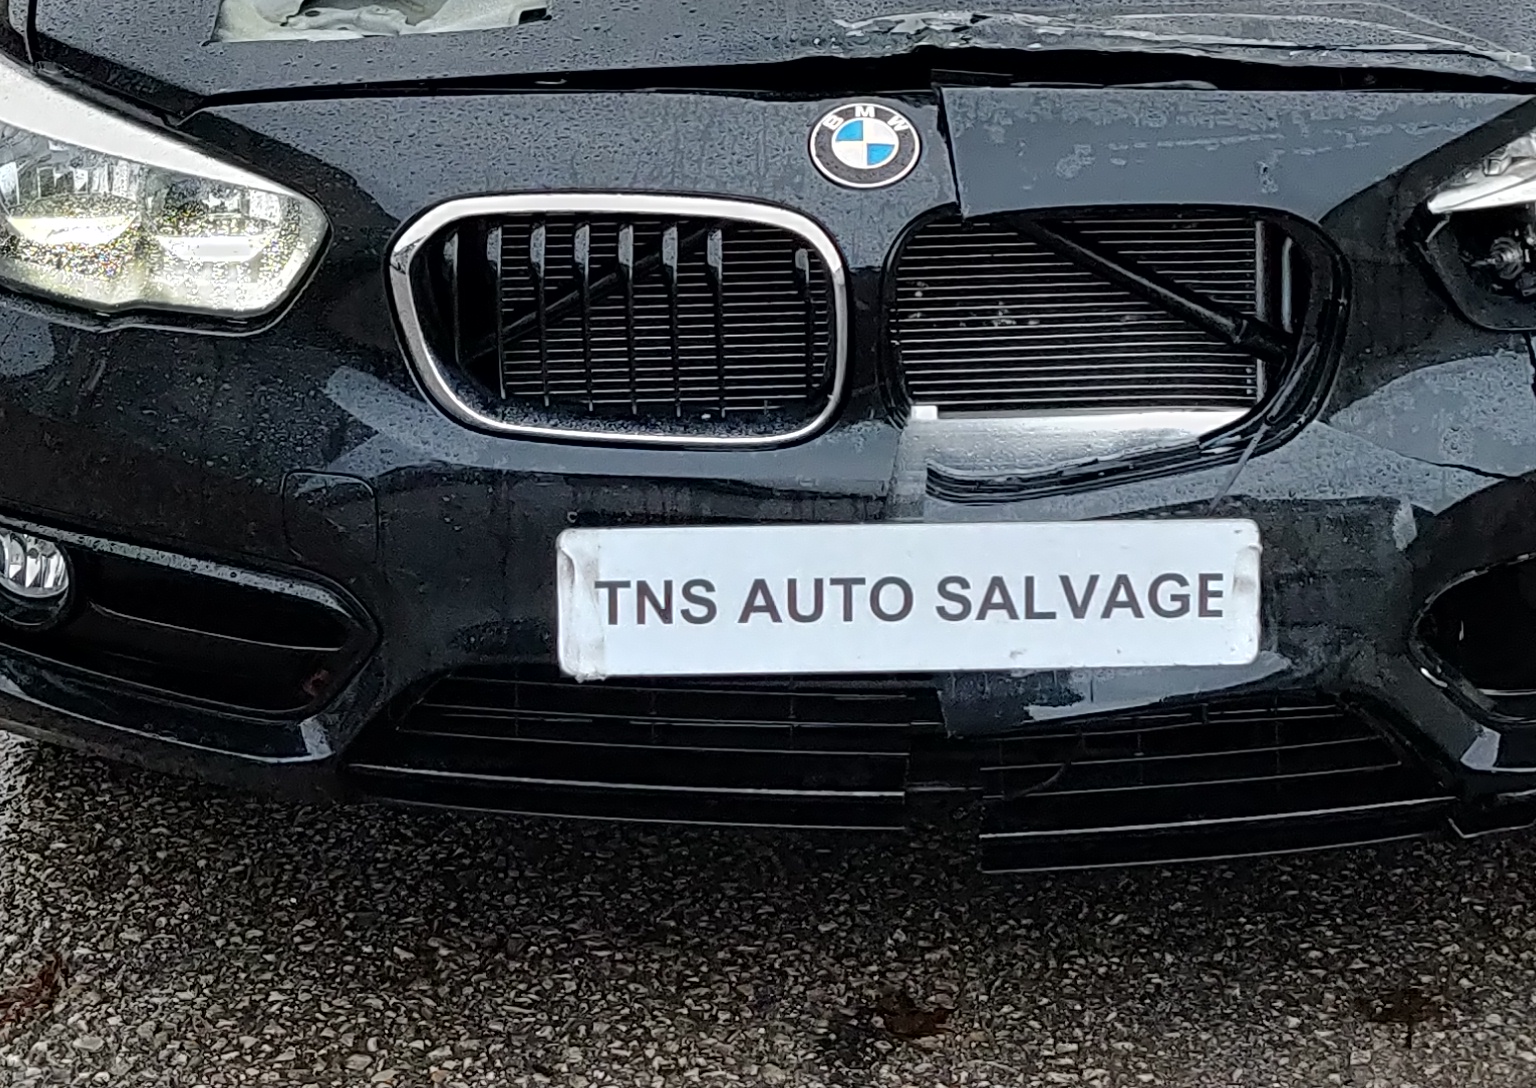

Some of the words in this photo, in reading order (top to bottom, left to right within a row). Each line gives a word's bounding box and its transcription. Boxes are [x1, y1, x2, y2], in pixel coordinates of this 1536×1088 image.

[823, 106, 909, 131] BMW
[595, 578, 718, 625] TNS
[737, 577, 914, 624] AUTO
[934, 573, 1224, 623] SALVAGE
